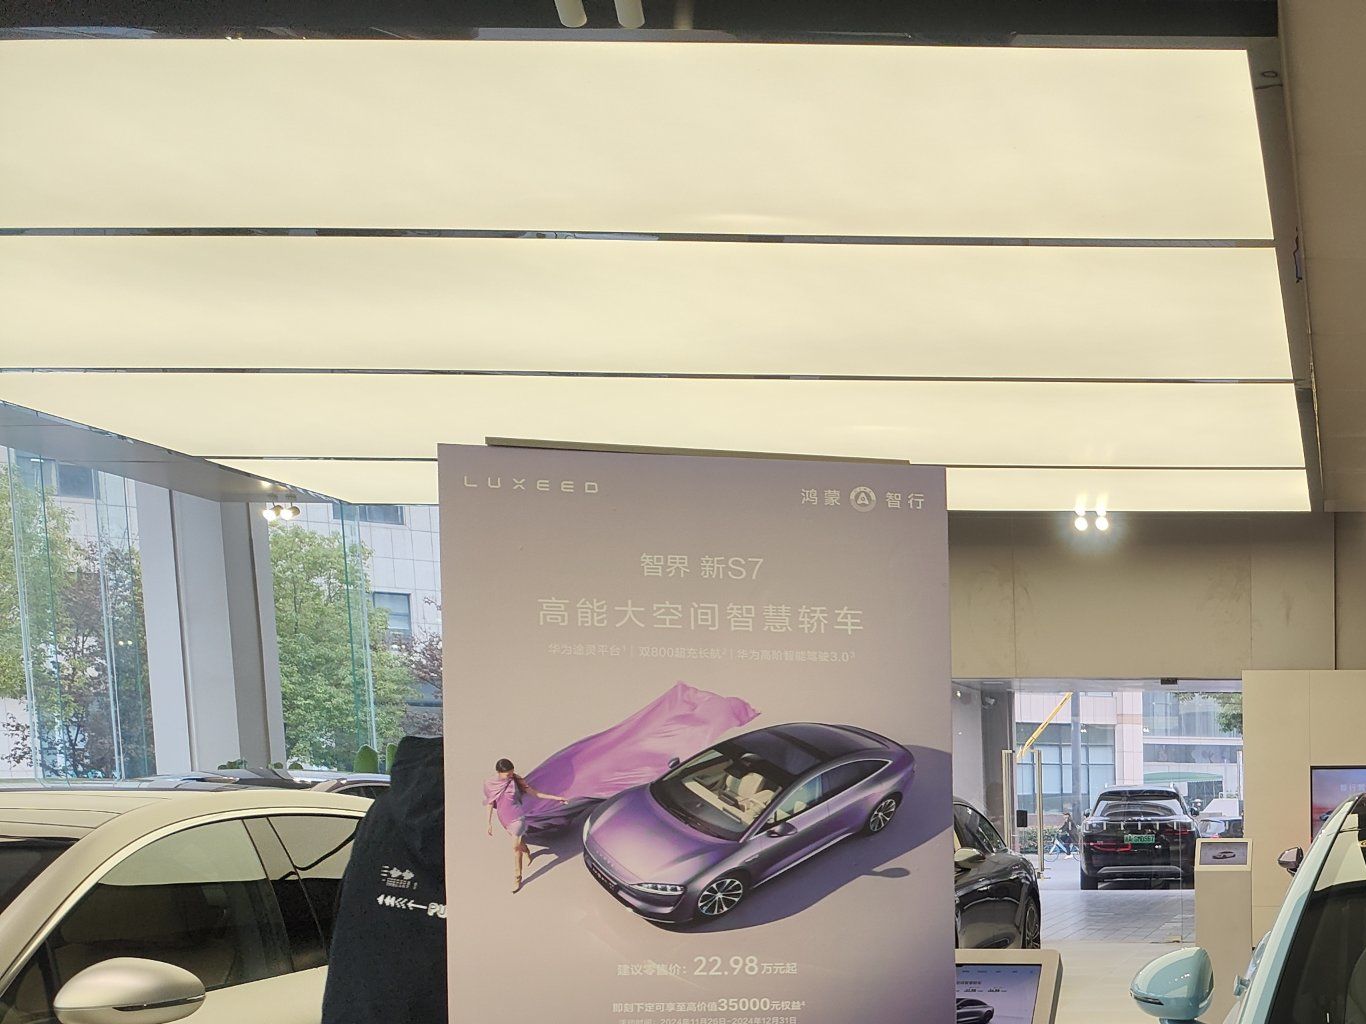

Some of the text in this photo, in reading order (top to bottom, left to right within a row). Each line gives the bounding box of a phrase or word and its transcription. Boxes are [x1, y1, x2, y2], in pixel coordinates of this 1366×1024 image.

[464, 475, 599, 494] LUXEED
[799, 488, 925, 510] 鸿蒙 智行
[639, 552, 764, 580] 智界 新S7
[537, 597, 864, 636] 高能大空间智慧轿车
